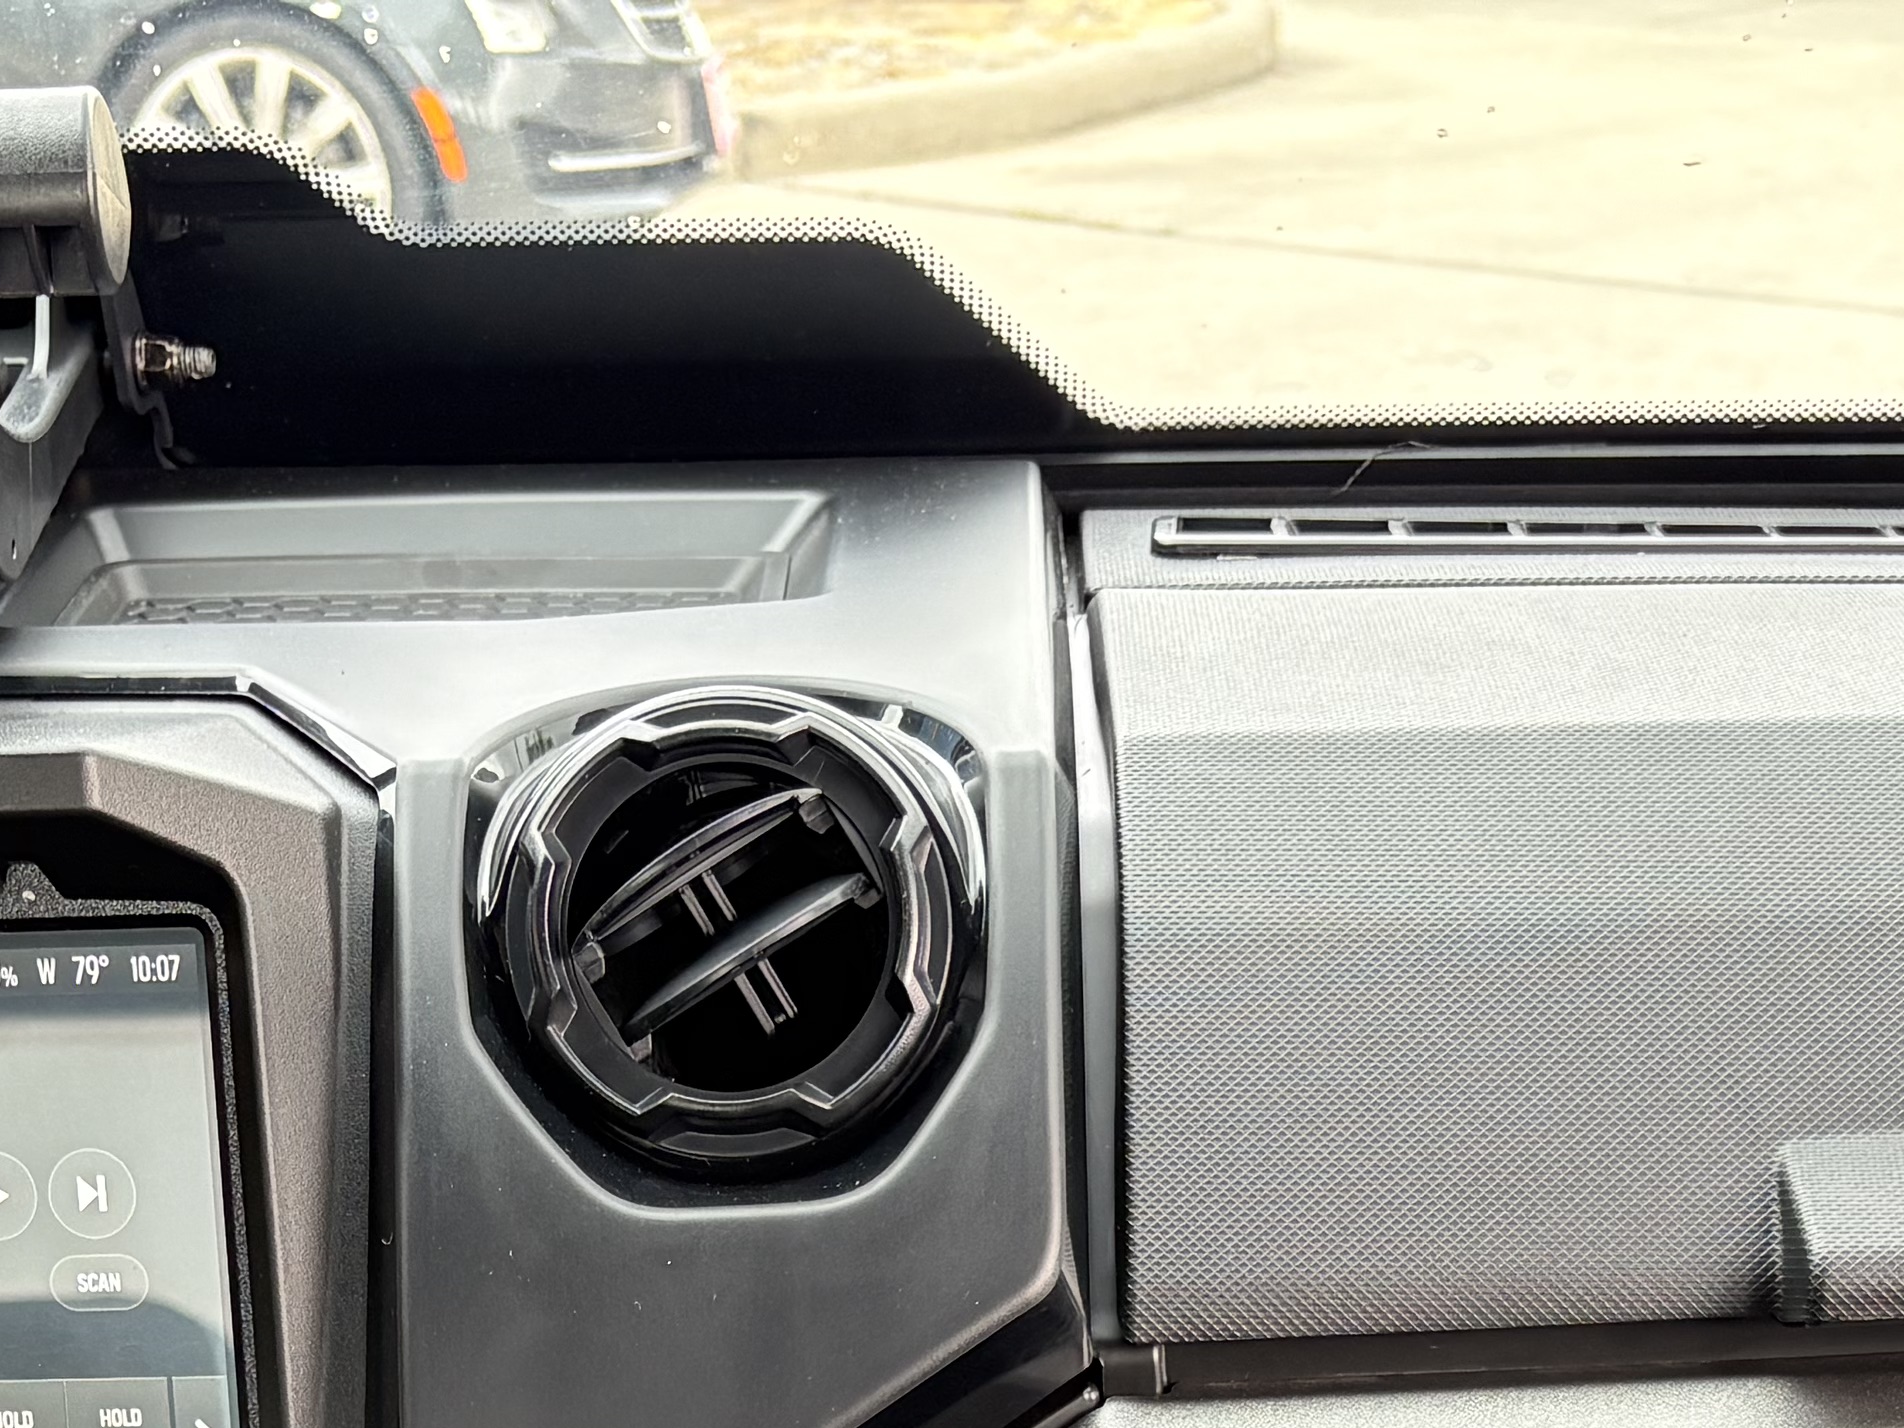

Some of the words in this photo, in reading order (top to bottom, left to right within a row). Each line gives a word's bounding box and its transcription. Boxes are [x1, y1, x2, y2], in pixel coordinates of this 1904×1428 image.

[37, 958, 55, 984] W
[72, 955, 109, 984] 79°
[130, 955, 180, 982] 10:07
[76, 1273, 124, 1292] SCAN
[100, 1408, 142, 1427] HOLD
